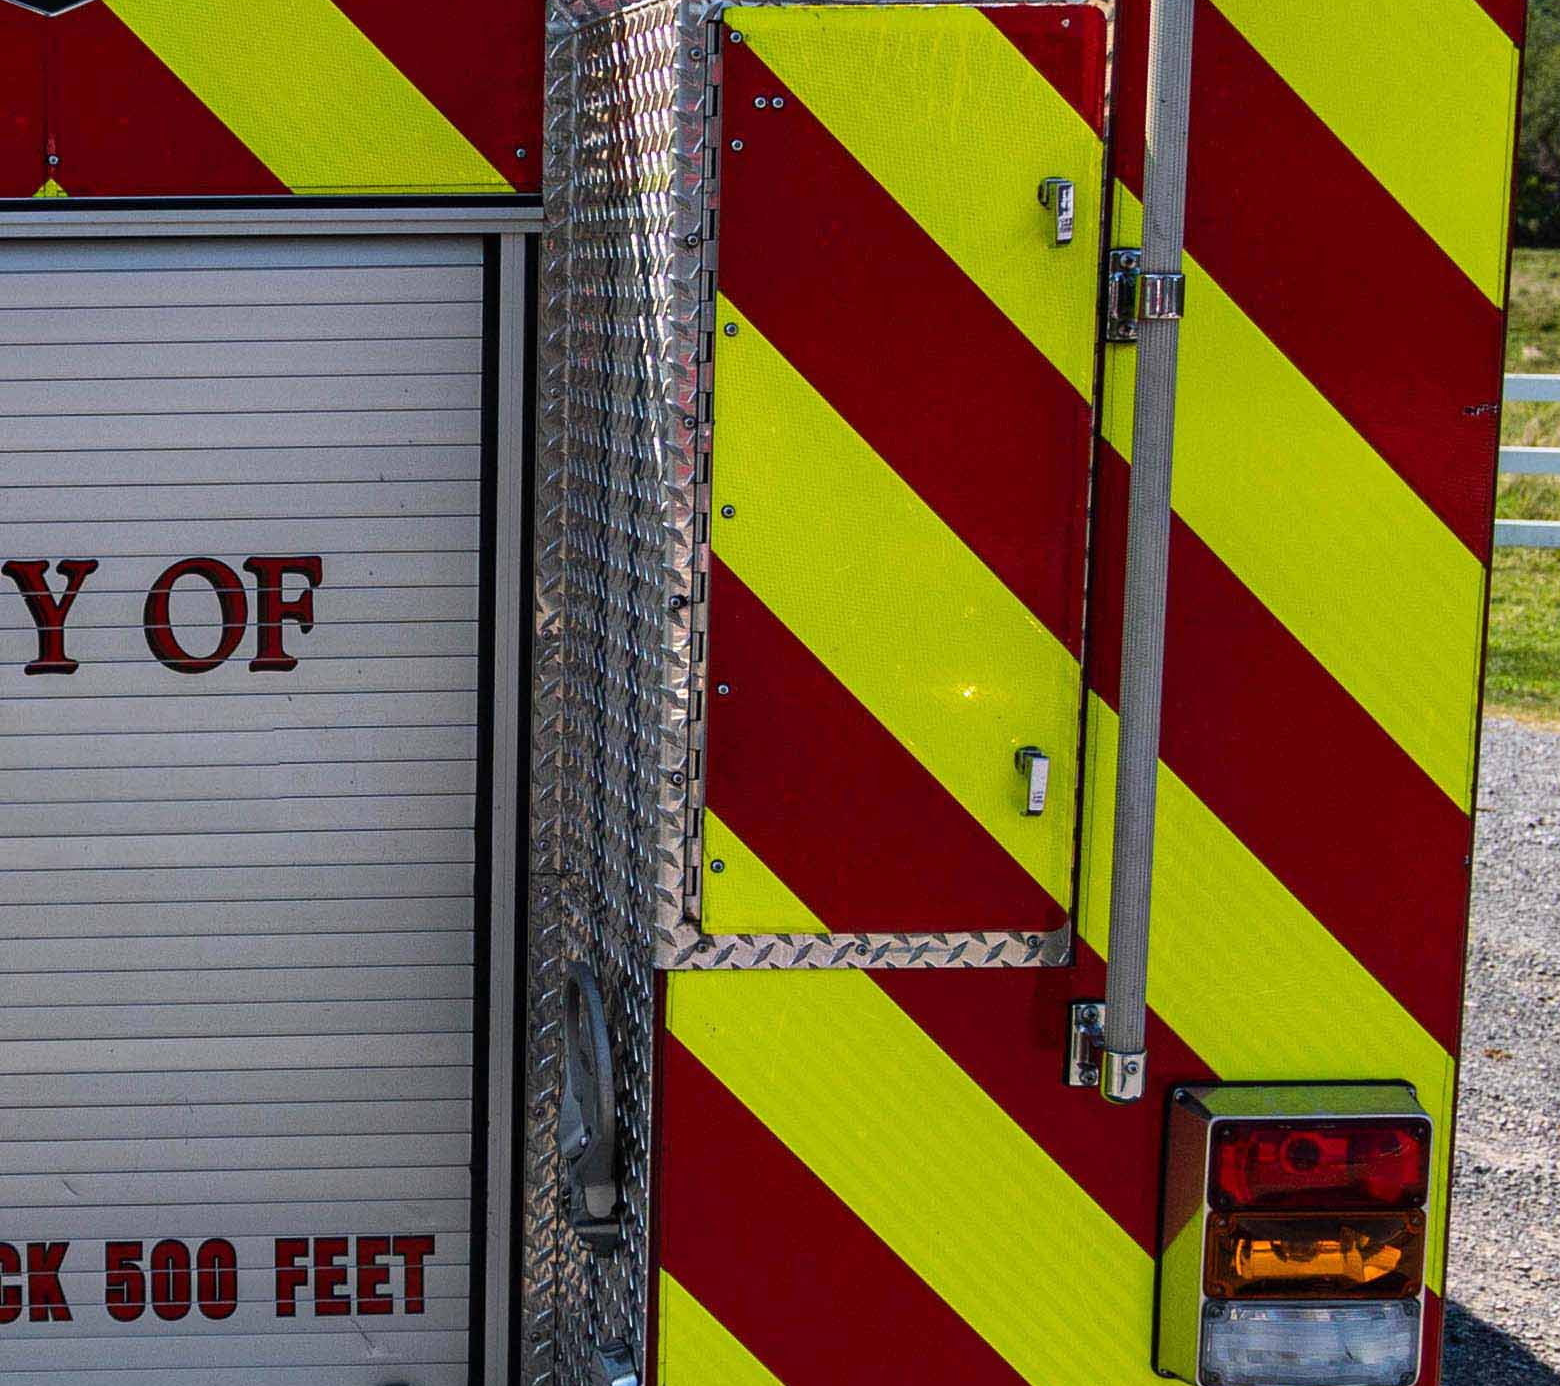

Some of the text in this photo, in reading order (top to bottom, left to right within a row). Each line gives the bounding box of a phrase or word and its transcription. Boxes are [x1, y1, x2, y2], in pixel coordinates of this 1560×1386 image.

[143, 556, 323, 675] OF
[103, 1238, 239, 1322] 500
[274, 1235, 436, 1318] FEET
